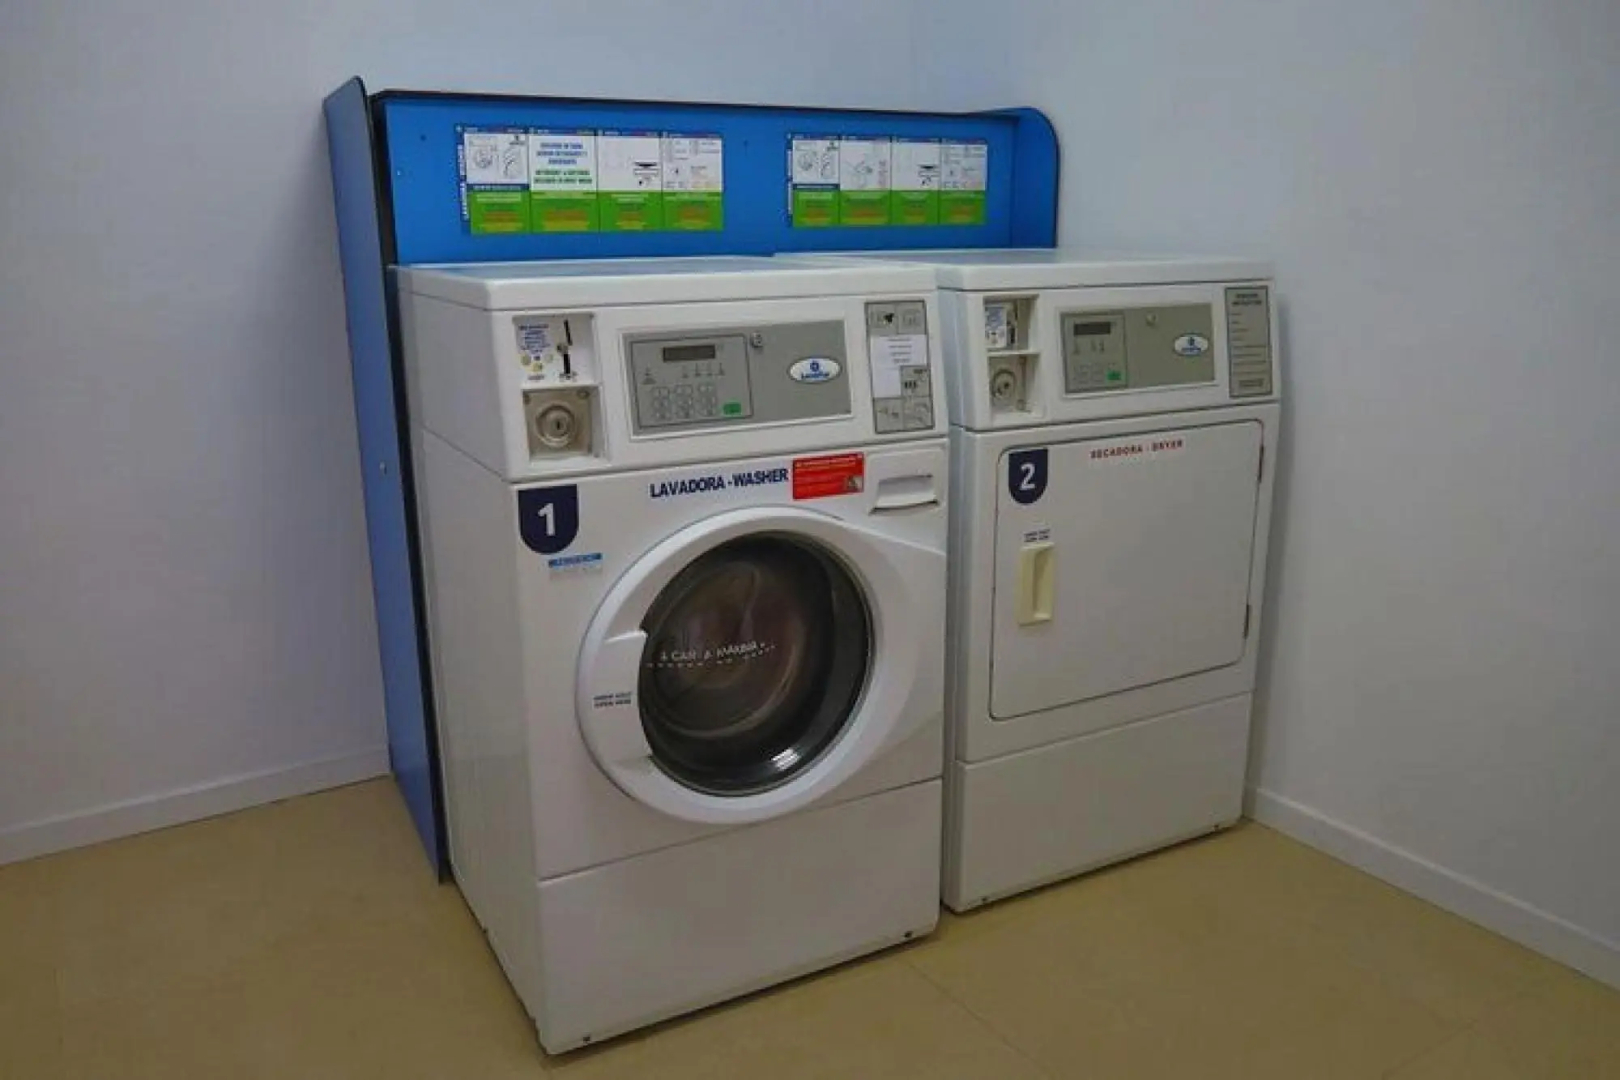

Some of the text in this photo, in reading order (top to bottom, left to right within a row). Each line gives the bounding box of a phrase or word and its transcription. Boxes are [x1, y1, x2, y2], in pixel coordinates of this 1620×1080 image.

[649, 476, 726, 499] LAVADORA
[732, 468, 789, 487] WASHER
[1019, 462, 1036, 491] 2
[537, 502, 557, 537] 1
